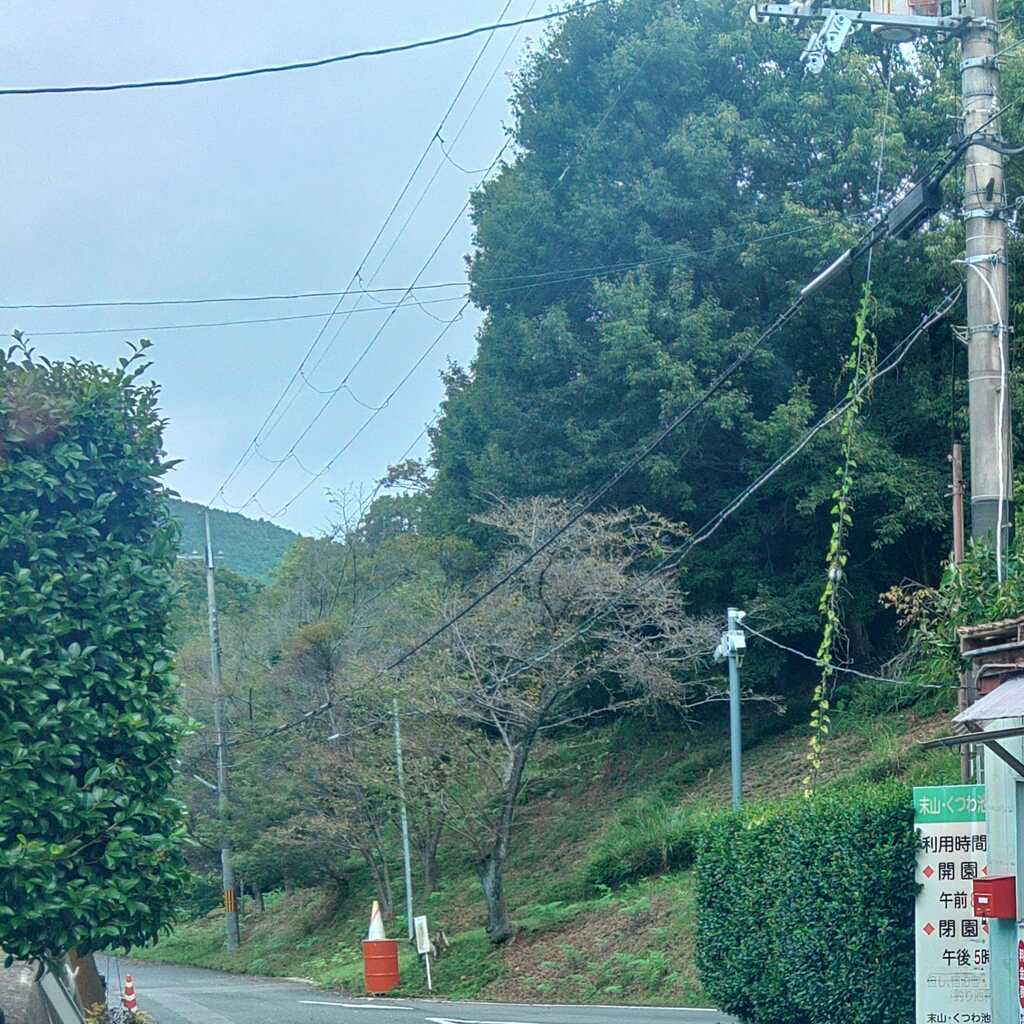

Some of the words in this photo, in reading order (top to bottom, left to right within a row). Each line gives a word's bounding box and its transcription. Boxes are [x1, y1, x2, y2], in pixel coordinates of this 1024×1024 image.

[921, 835, 987, 853] 利用時間
[938, 862, 978, 881] 開園
[939, 892, 968, 909] 午前
[938, 919, 979, 938] 閉園
[927, 1012, 992, 1024] 末山・くつわ池
